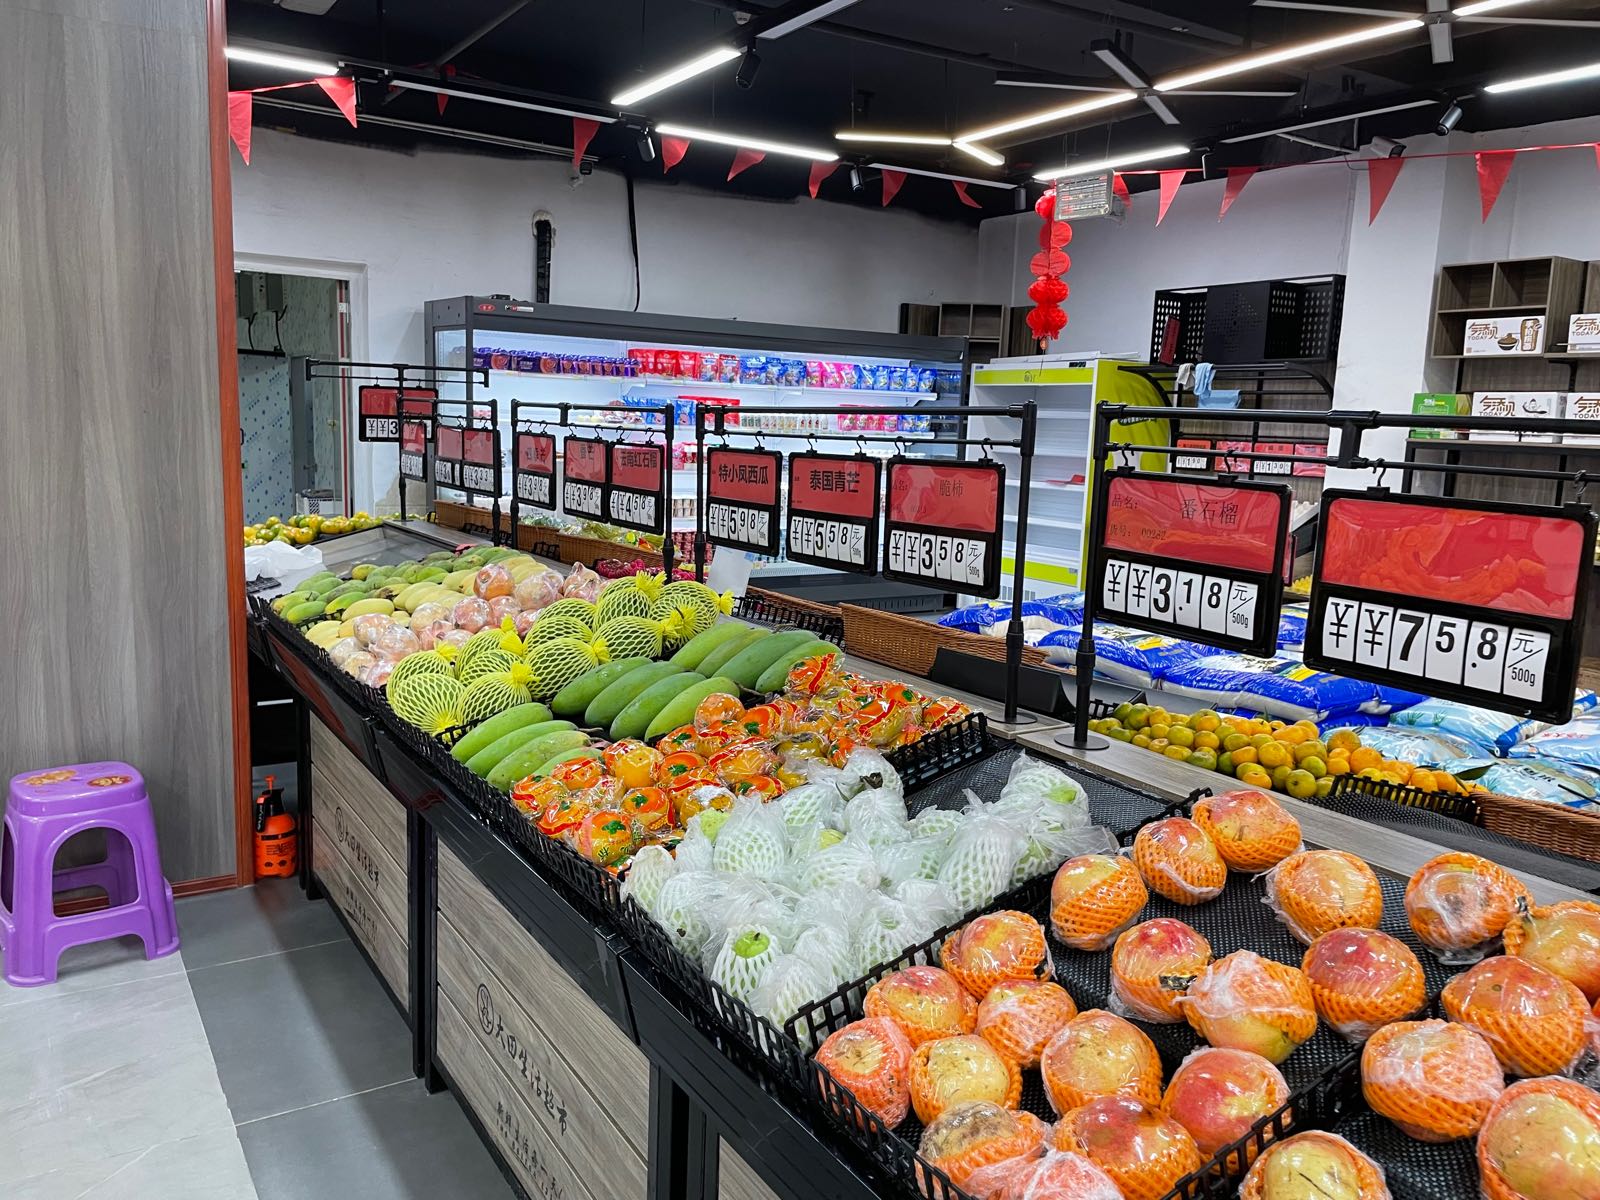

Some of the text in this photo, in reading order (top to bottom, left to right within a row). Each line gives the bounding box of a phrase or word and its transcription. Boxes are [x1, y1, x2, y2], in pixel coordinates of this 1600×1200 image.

[719, 463, 769, 485] 特小凤西瓜
[809, 469, 860, 493] 泰国青芒
[939, 480, 965, 497] 脆柿
[1181, 499, 1239, 525] 番石榴
